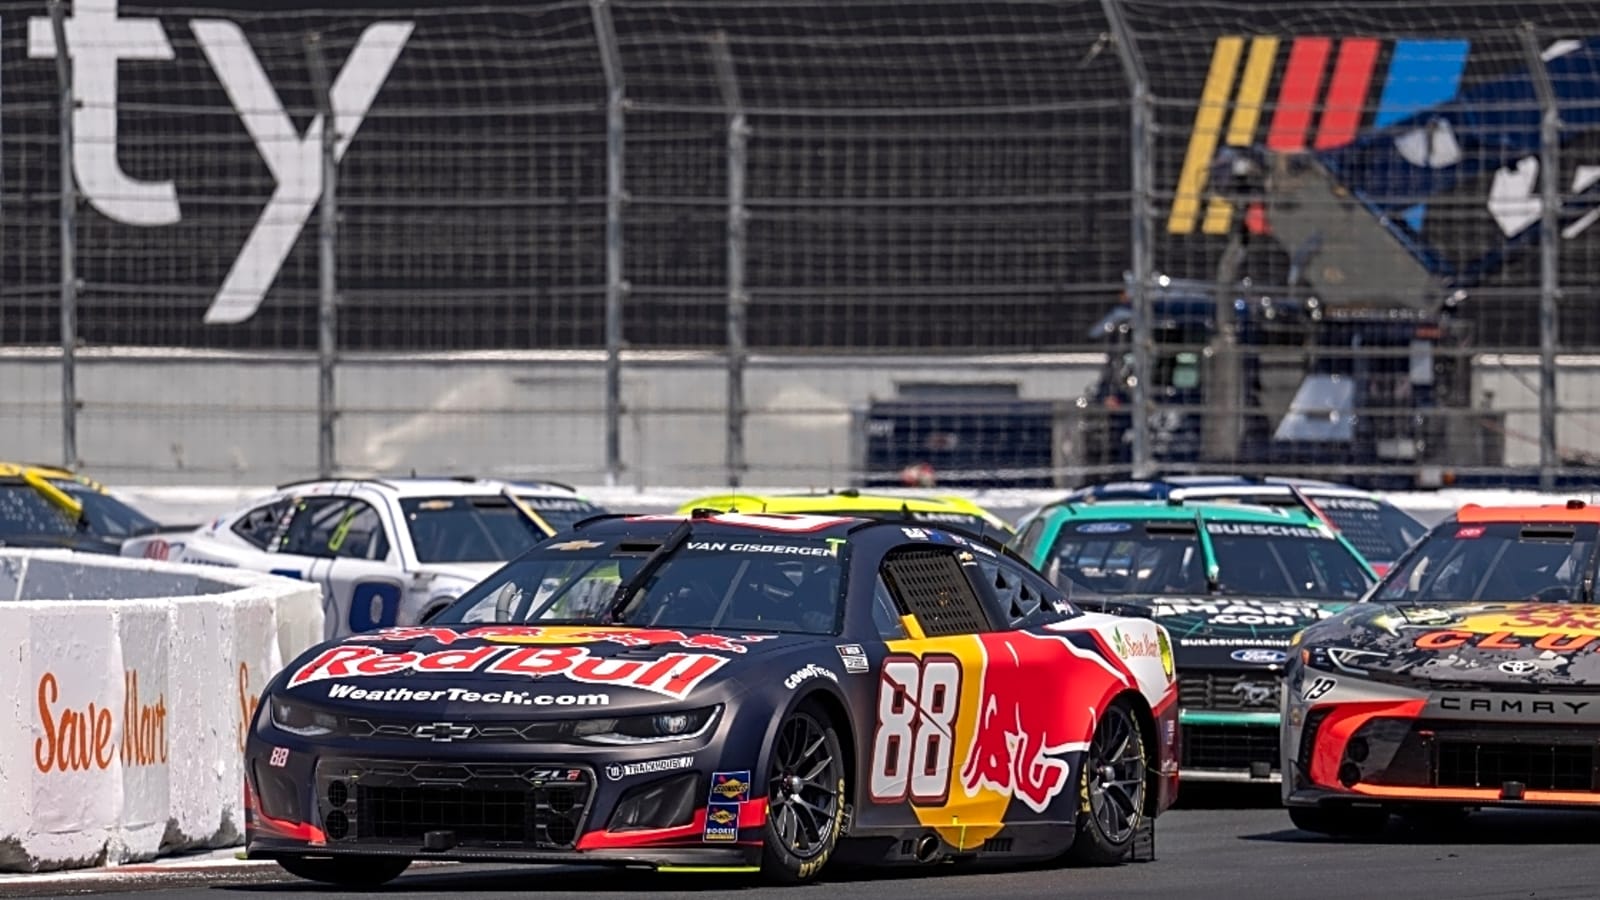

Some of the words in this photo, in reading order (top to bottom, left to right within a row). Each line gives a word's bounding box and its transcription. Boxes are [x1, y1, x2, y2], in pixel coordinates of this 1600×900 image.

[686, 542, 727, 551] VAN
[729, 543, 837, 557] GISBERGEN
[1208, 614, 1294, 625] .COM
[288, 645, 497, 688] Red
[484, 647, 730, 699] Bull
[327, 684, 610, 706] WeatherTech.com
[1302, 677, 1336, 700] 19
[35, 672, 116, 774] Save
[119, 669, 168, 768] Mart
[868, 652, 964, 806] 88
[269, 746, 289, 768] 88
